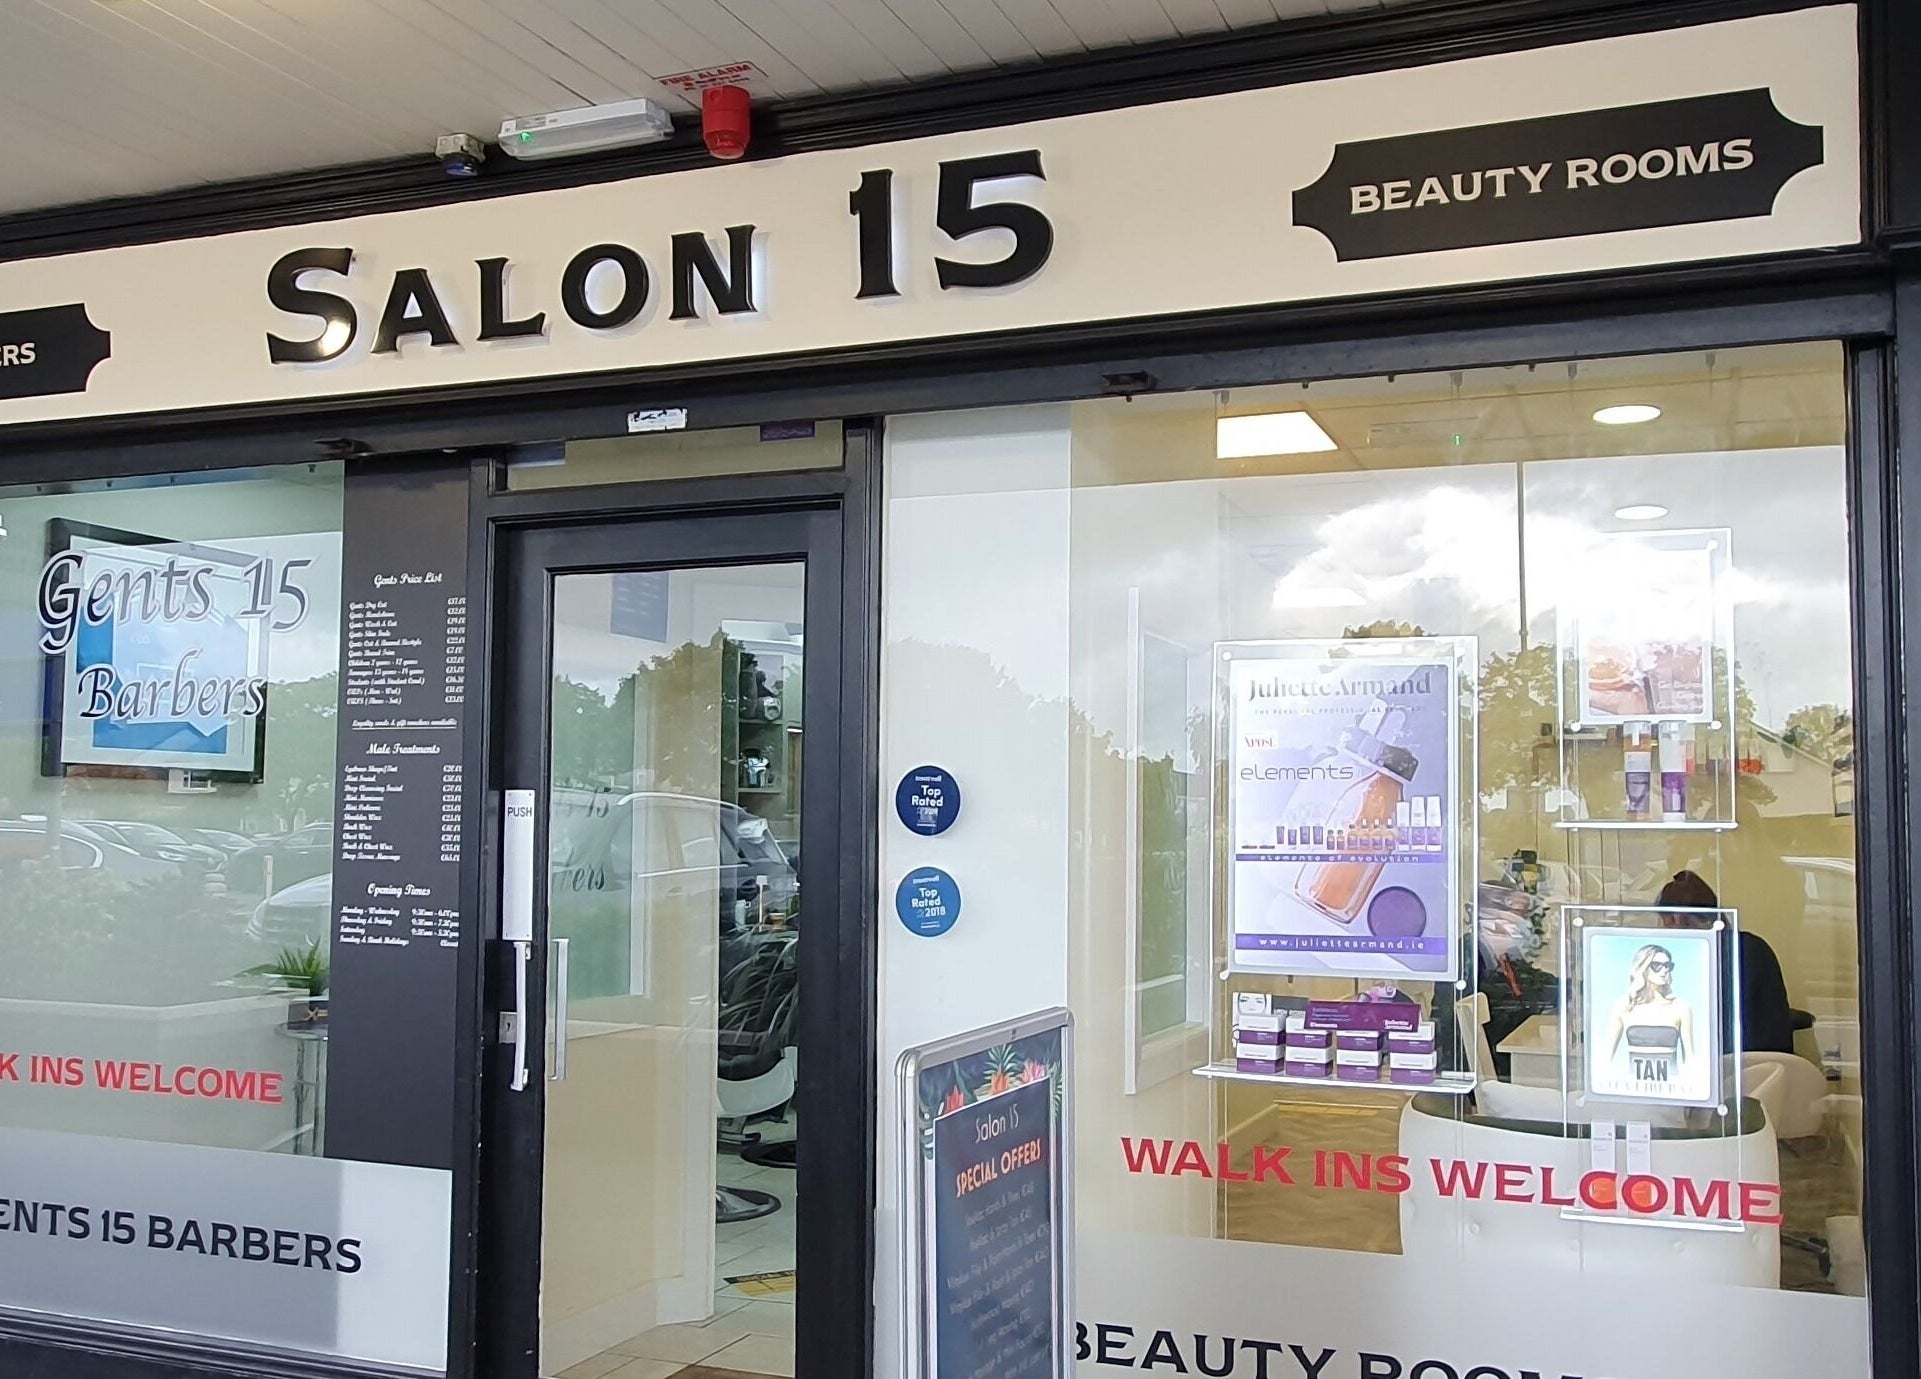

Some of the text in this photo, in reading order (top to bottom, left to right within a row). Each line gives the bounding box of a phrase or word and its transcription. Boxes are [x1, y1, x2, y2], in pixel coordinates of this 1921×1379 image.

[1350, 138, 1754, 215] BEAUTY ROOMS
[849, 149, 1054, 300] 15
[0, 342, 37, 367] RS
[399, 572, 422, 584] Price
[424, 571, 443, 583] List
[38, 549, 315, 652] Gents 15
[77, 648, 269, 720] Barbers
[1240, 763, 1354, 781] elements
[911, 795, 944, 807] Rated
[921, 785, 942, 799] Top
[507, 806, 533, 818] PUSH
[404, 884, 431, 896] Times
[911, 895, 941, 908] Rated
[918, 887, 938, 899] Top
[30, 1055, 84, 1086] INS
[94, 1059, 284, 1103] WELCOME
[1634, 1058, 1668, 1082] TAN
[975, 1103, 1019, 1144] Salon 15
[956, 1138, 1041, 1198] SPECIAL OFFERS
[1119, 1136, 1786, 1226] WALK INS WELCOME
[101, 1209, 136, 1245] 15
[147, 1214, 362, 1274] BARBERS
